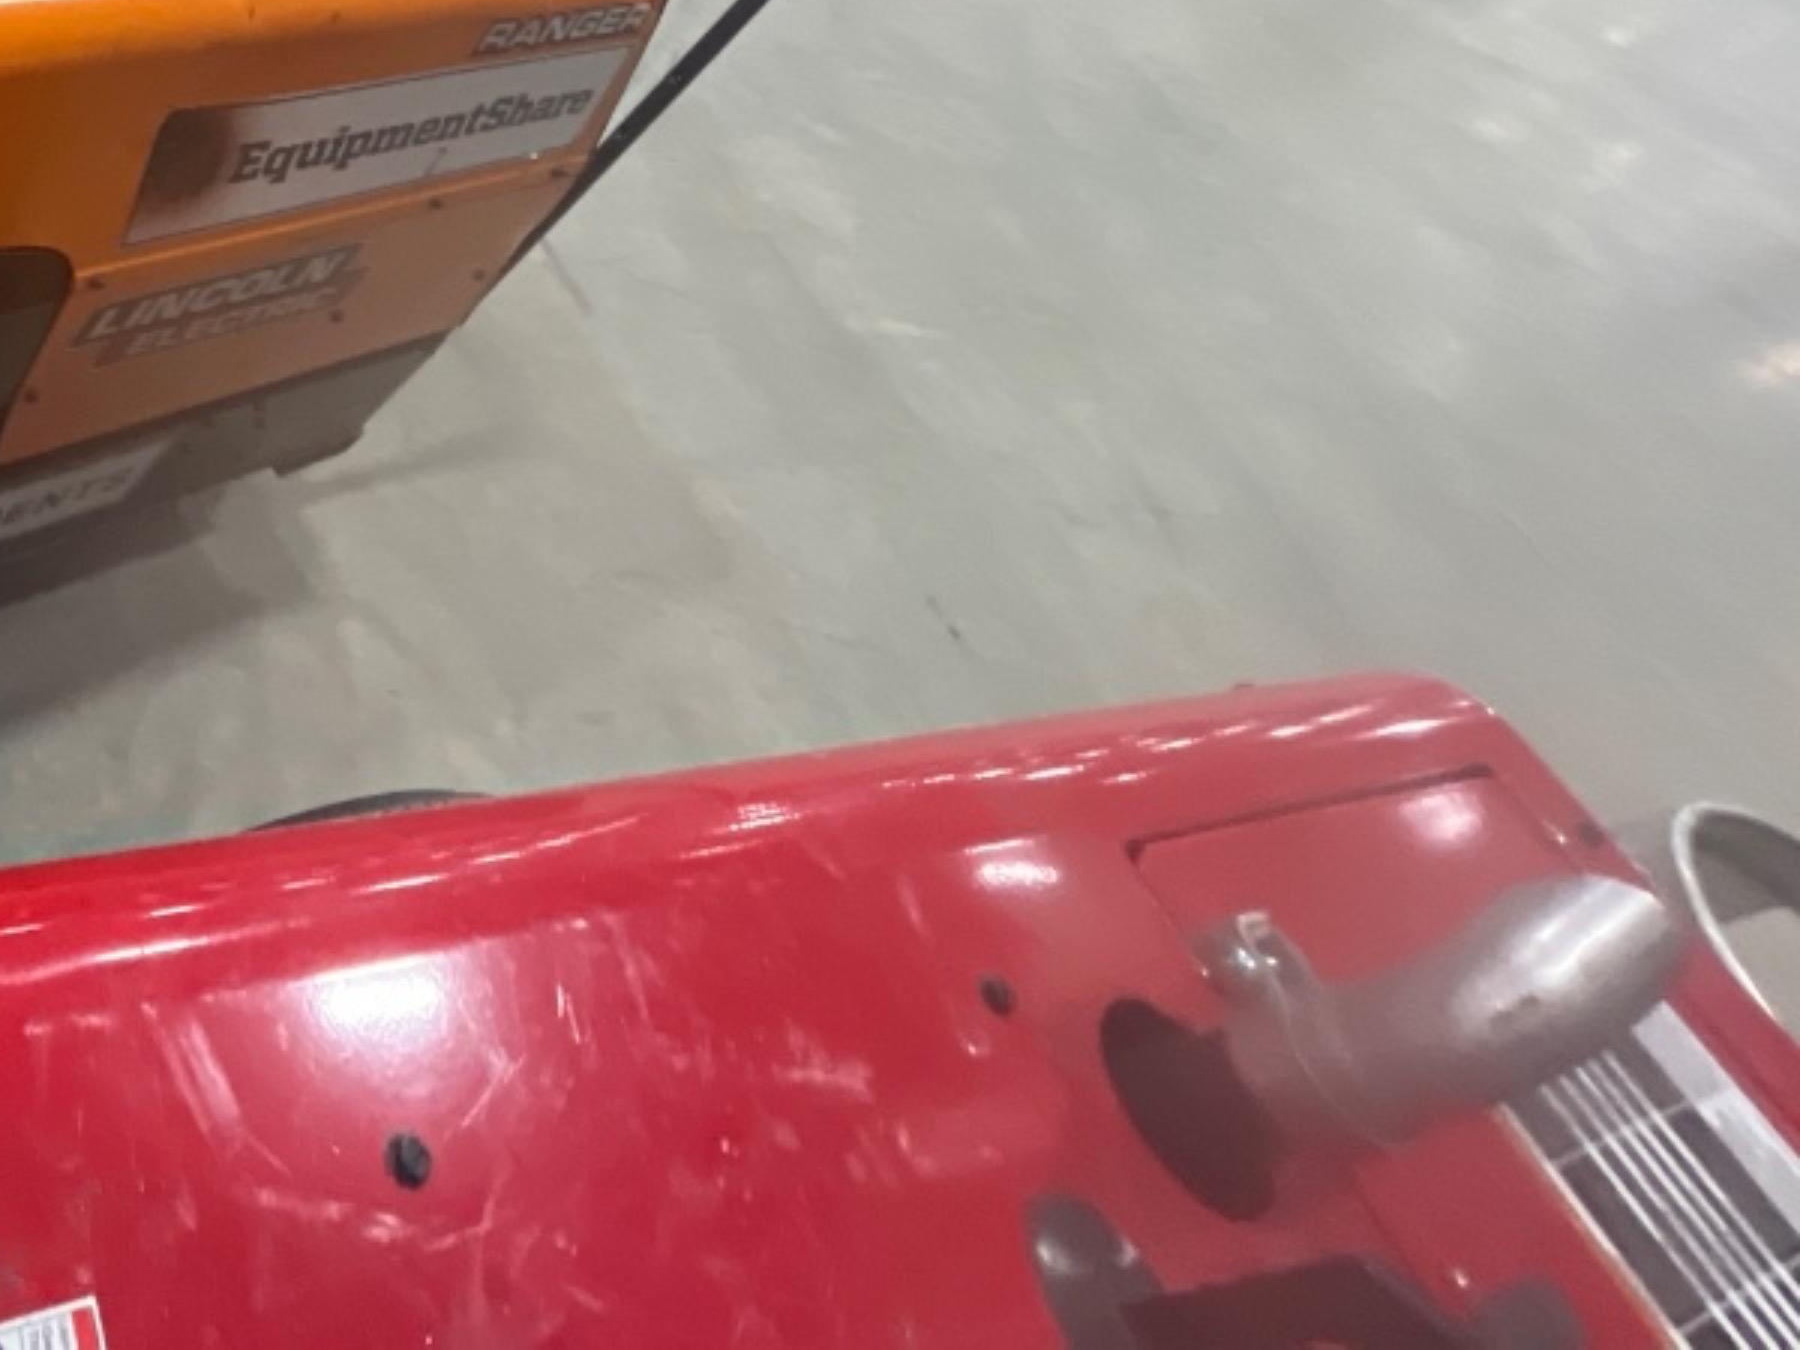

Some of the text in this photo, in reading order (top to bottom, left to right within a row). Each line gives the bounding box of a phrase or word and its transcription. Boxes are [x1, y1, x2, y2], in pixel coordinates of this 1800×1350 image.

[477, 1, 653, 52] RANGER
[229, 87, 595, 187] EquipmentShare
[88, 249, 352, 339] LINCOLN
